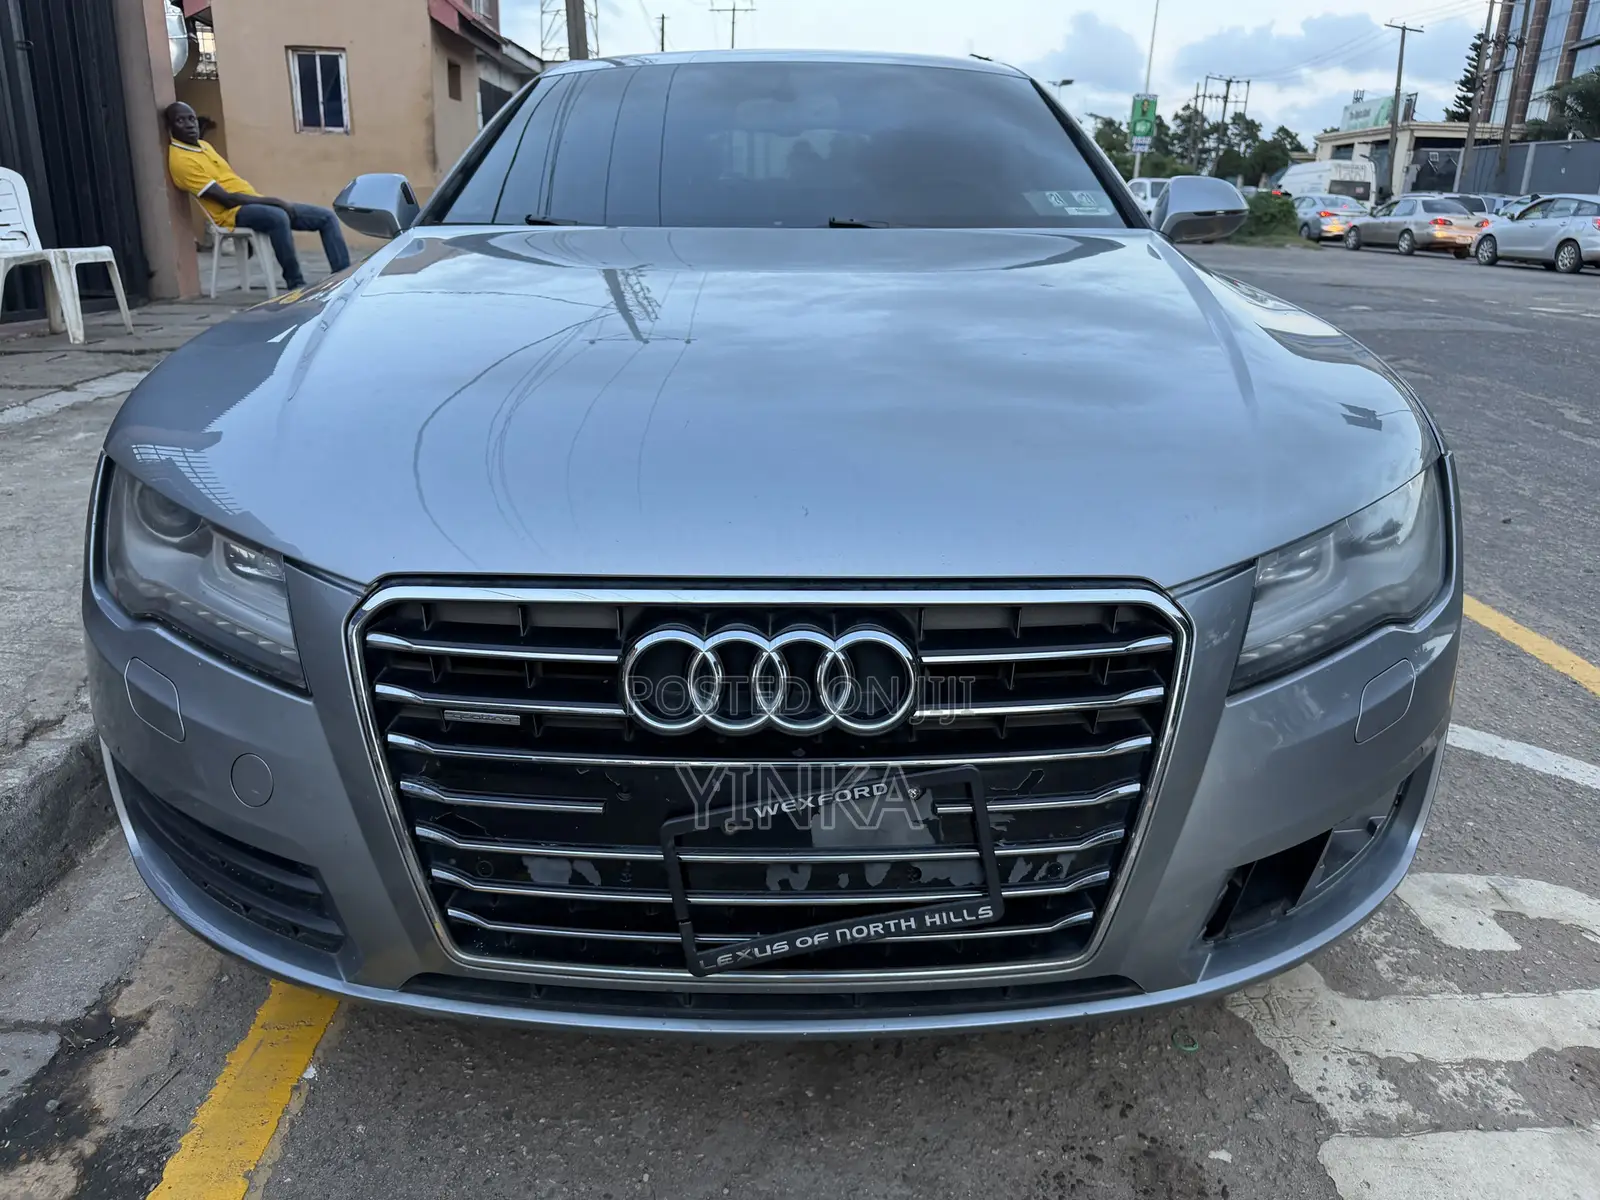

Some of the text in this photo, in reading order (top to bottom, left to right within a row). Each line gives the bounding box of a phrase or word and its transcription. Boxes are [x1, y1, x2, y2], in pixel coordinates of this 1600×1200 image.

[753, 783, 888, 818] WEXFORD
[699, 905, 993, 969] LEXUS OF NORTH HILLS
